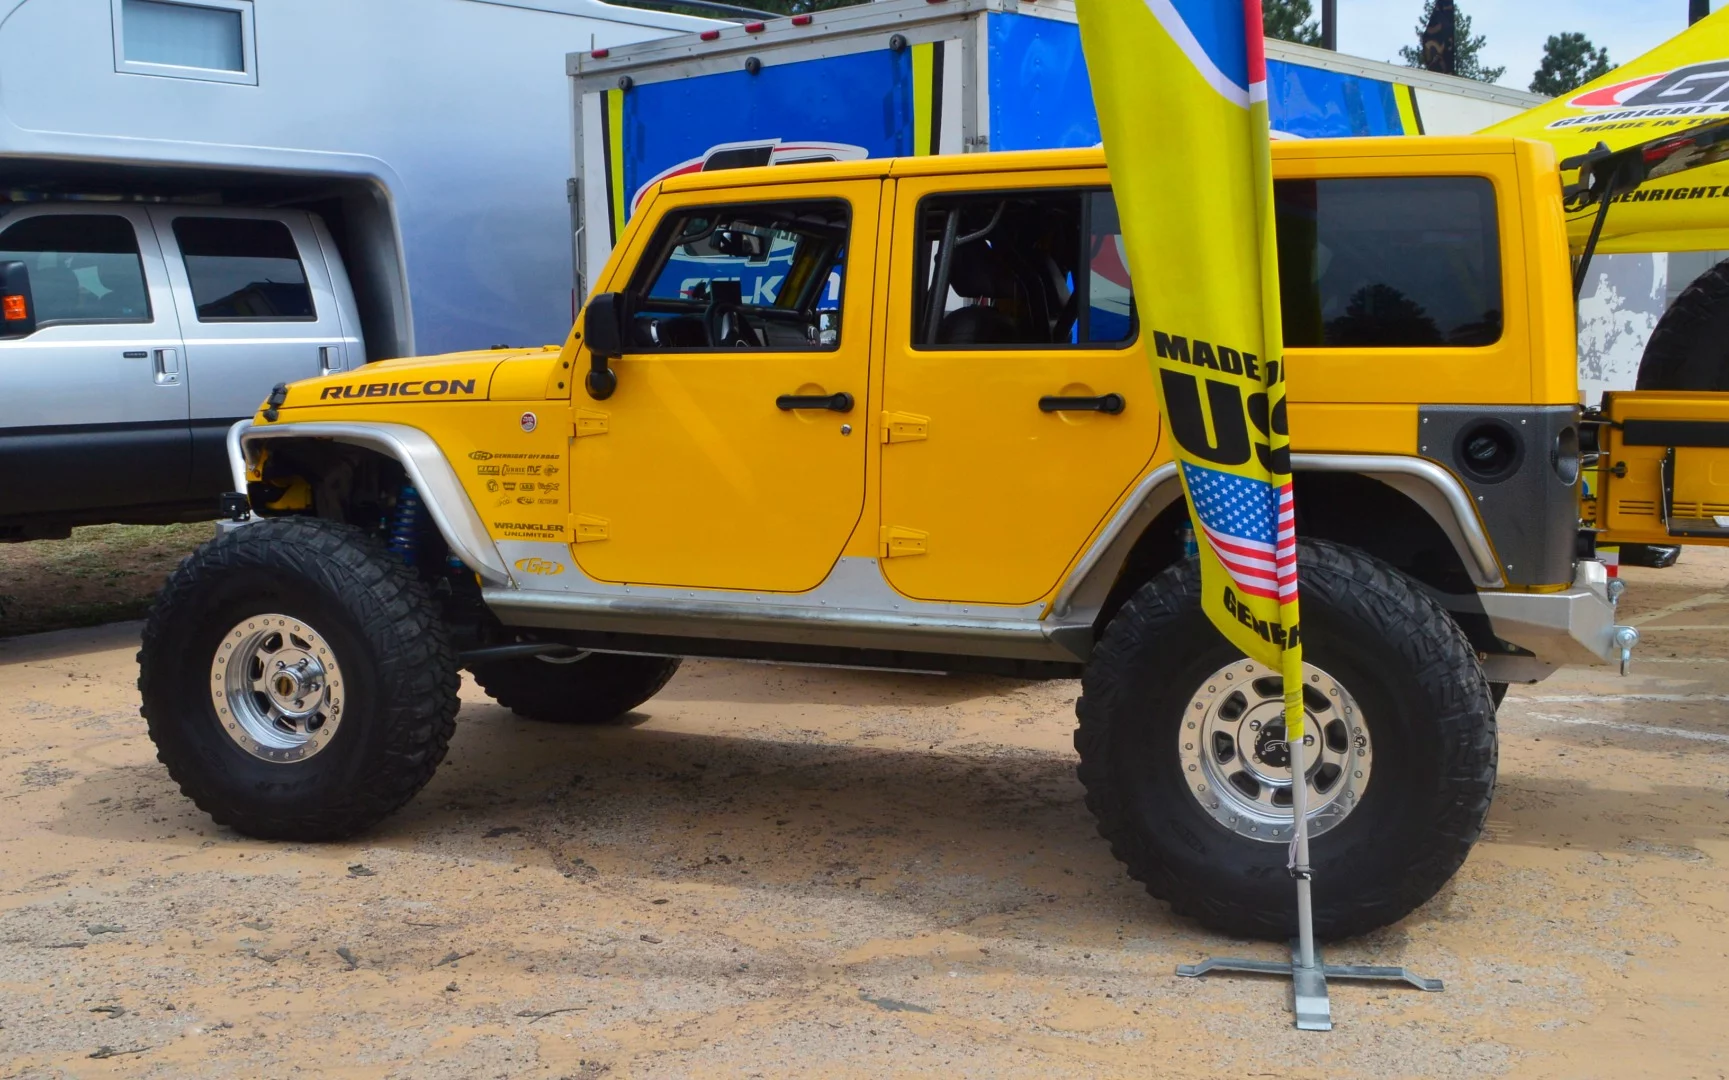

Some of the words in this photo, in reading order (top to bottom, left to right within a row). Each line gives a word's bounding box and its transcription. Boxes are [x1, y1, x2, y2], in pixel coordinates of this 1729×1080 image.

[1550, 105, 1715, 127] GENRIGHT
[1579, 121, 1646, 133] MADE
[1651, 119, 1681, 127] IN
[1153, 330, 1262, 382] MADE
[320, 379, 476, 400] RUBICON
[494, 522, 564, 532] WRANGLER
